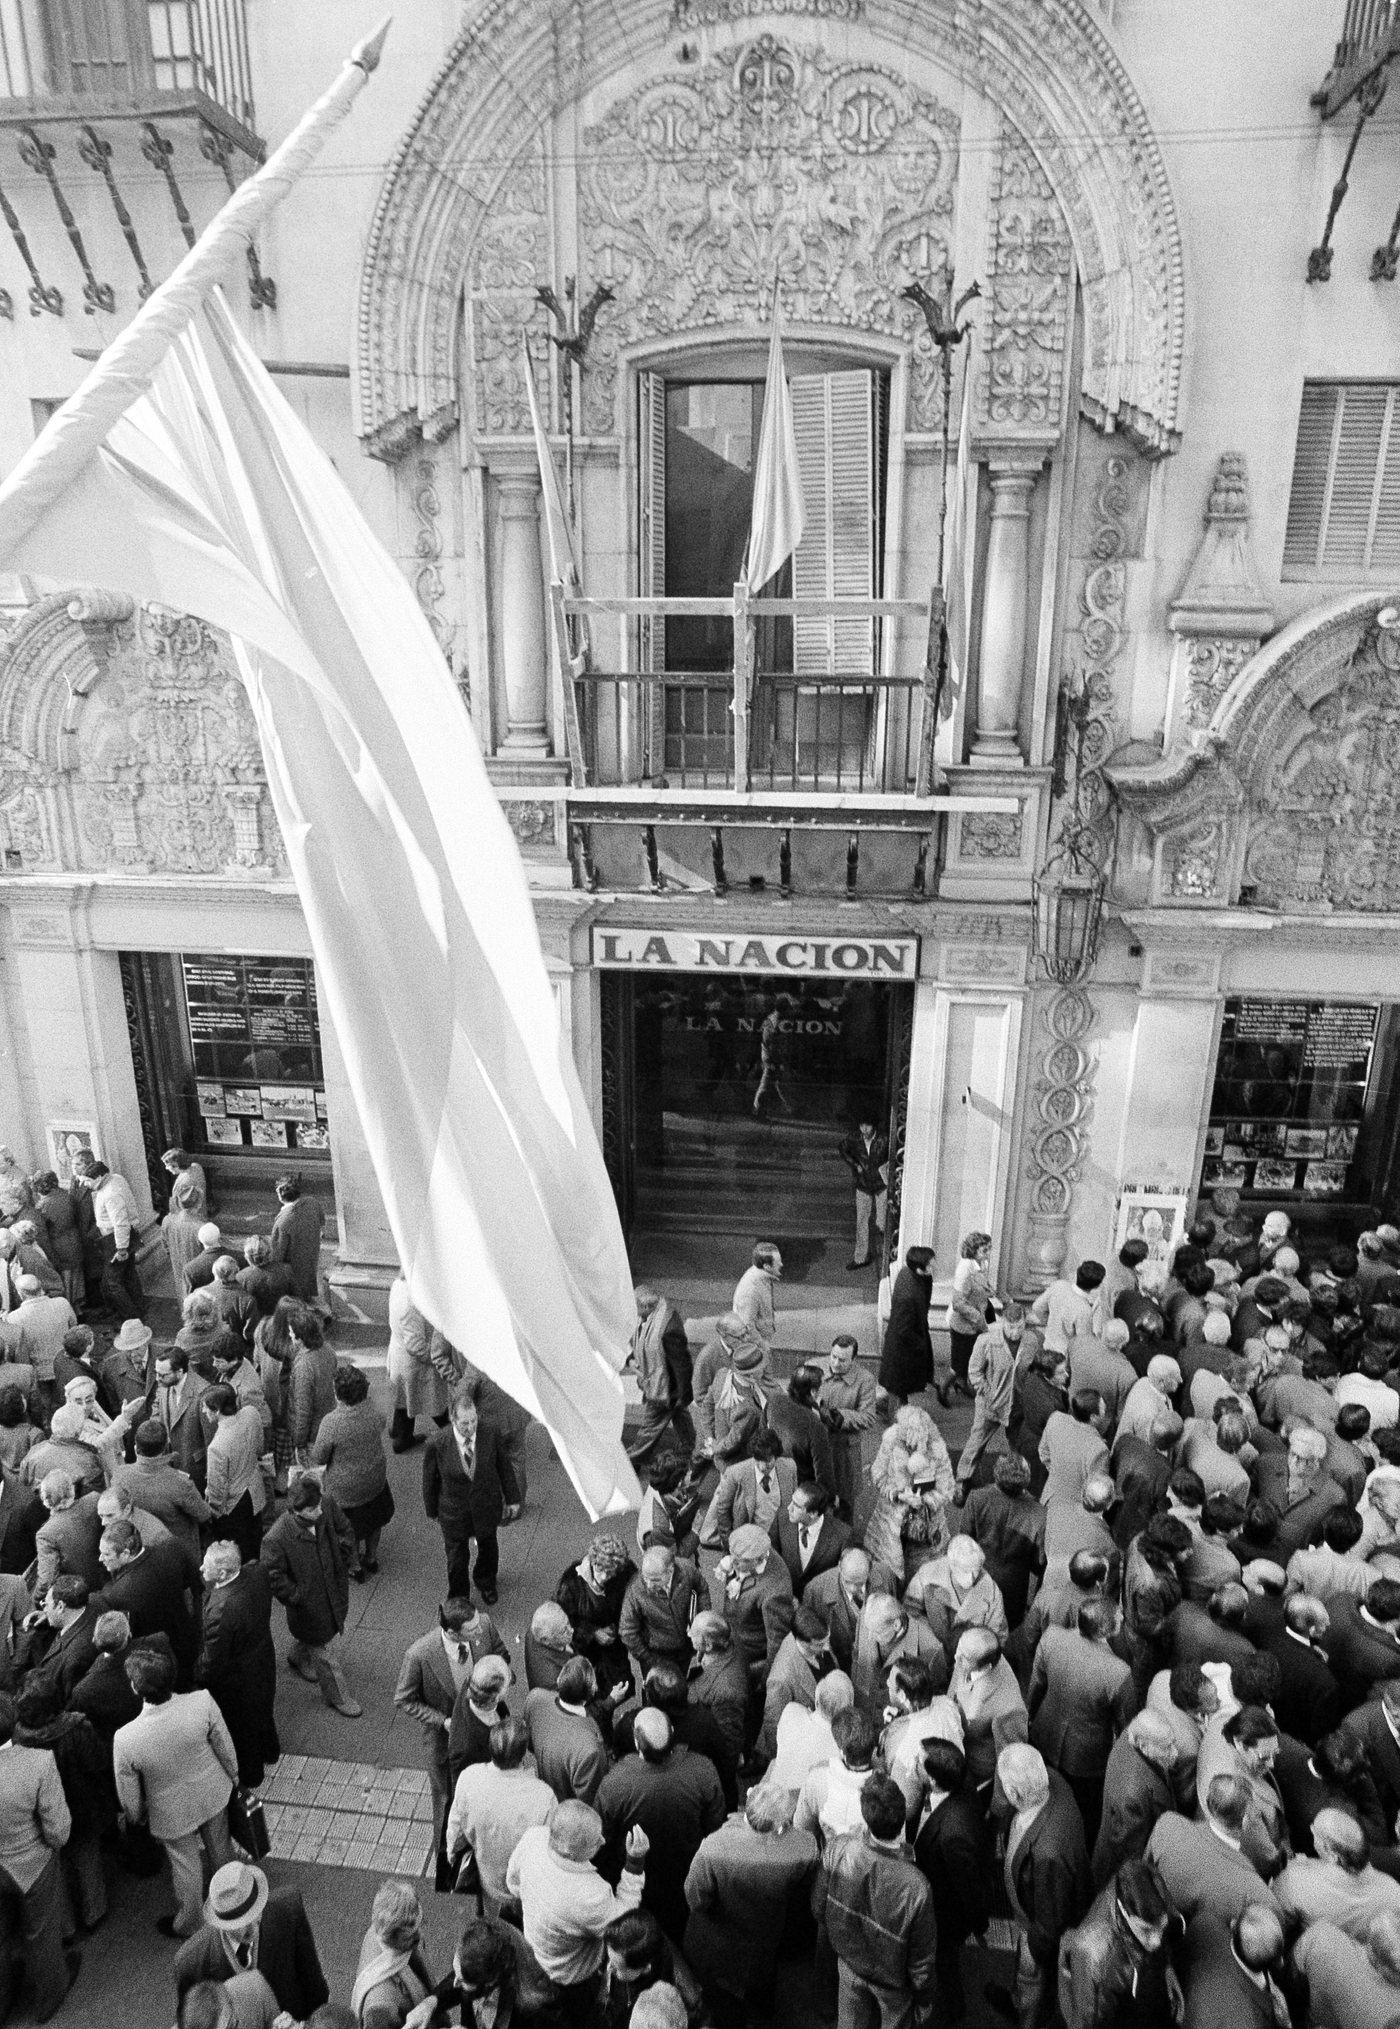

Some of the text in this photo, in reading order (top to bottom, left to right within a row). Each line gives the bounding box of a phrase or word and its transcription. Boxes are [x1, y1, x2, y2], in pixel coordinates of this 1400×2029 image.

[599, 934, 910, 973] LA NACION
[684, 1016, 724, 1031] LA
